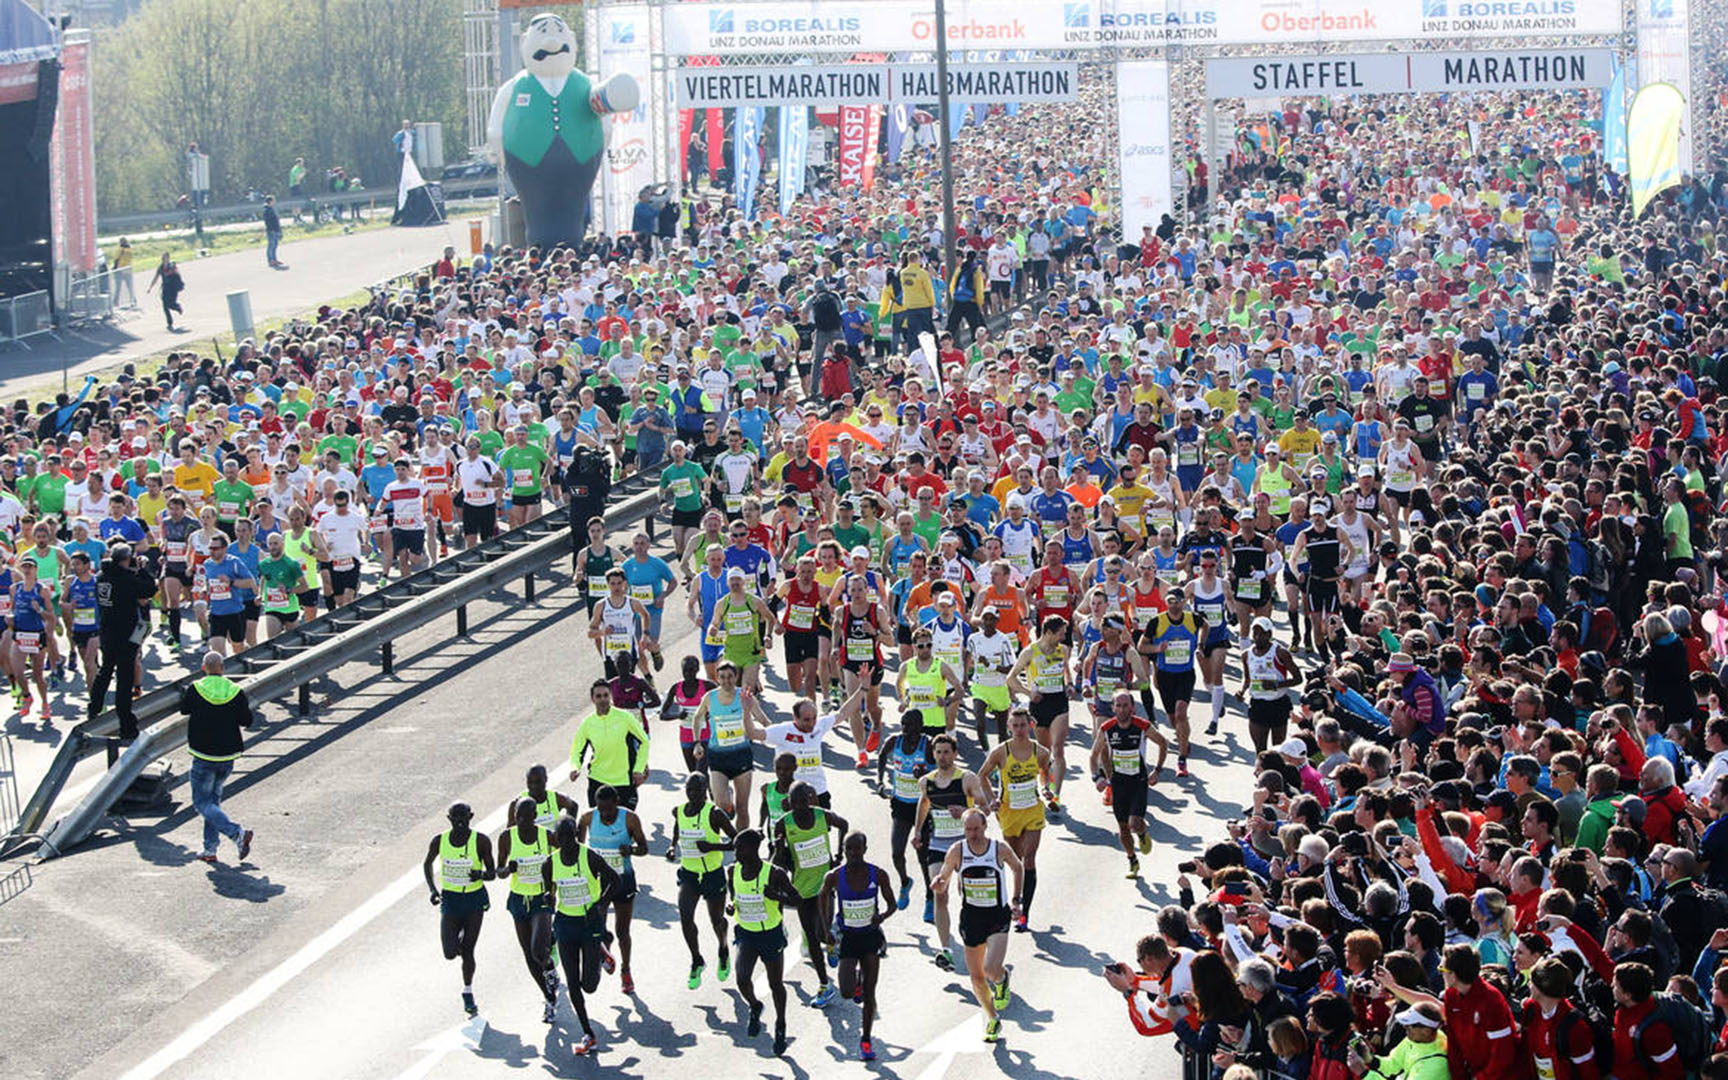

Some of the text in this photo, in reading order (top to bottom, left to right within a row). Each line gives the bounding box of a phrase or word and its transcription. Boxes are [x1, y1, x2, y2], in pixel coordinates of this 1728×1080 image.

[1459, 1, 1576, 16] BOREALIS
[745, 18, 861, 32] BOREALIS
[1100, 11, 1217, 26] BOREALIS
[1261, 10, 1376, 31] Oberbank
[1422, 18, 1576, 32] LINZ DONAU MARATHON
[709, 35, 861, 47] LINZ DONAU MARATHON
[1064, 28, 1218, 42] LINZ DONAU MARATHON
[1253, 61, 1363, 90] STAFFEL
[1445, 55, 1585, 84] MARATHON
[686, 73, 880, 100] VIERTELMARATHON
[841, 104, 866, 185] KAISE
